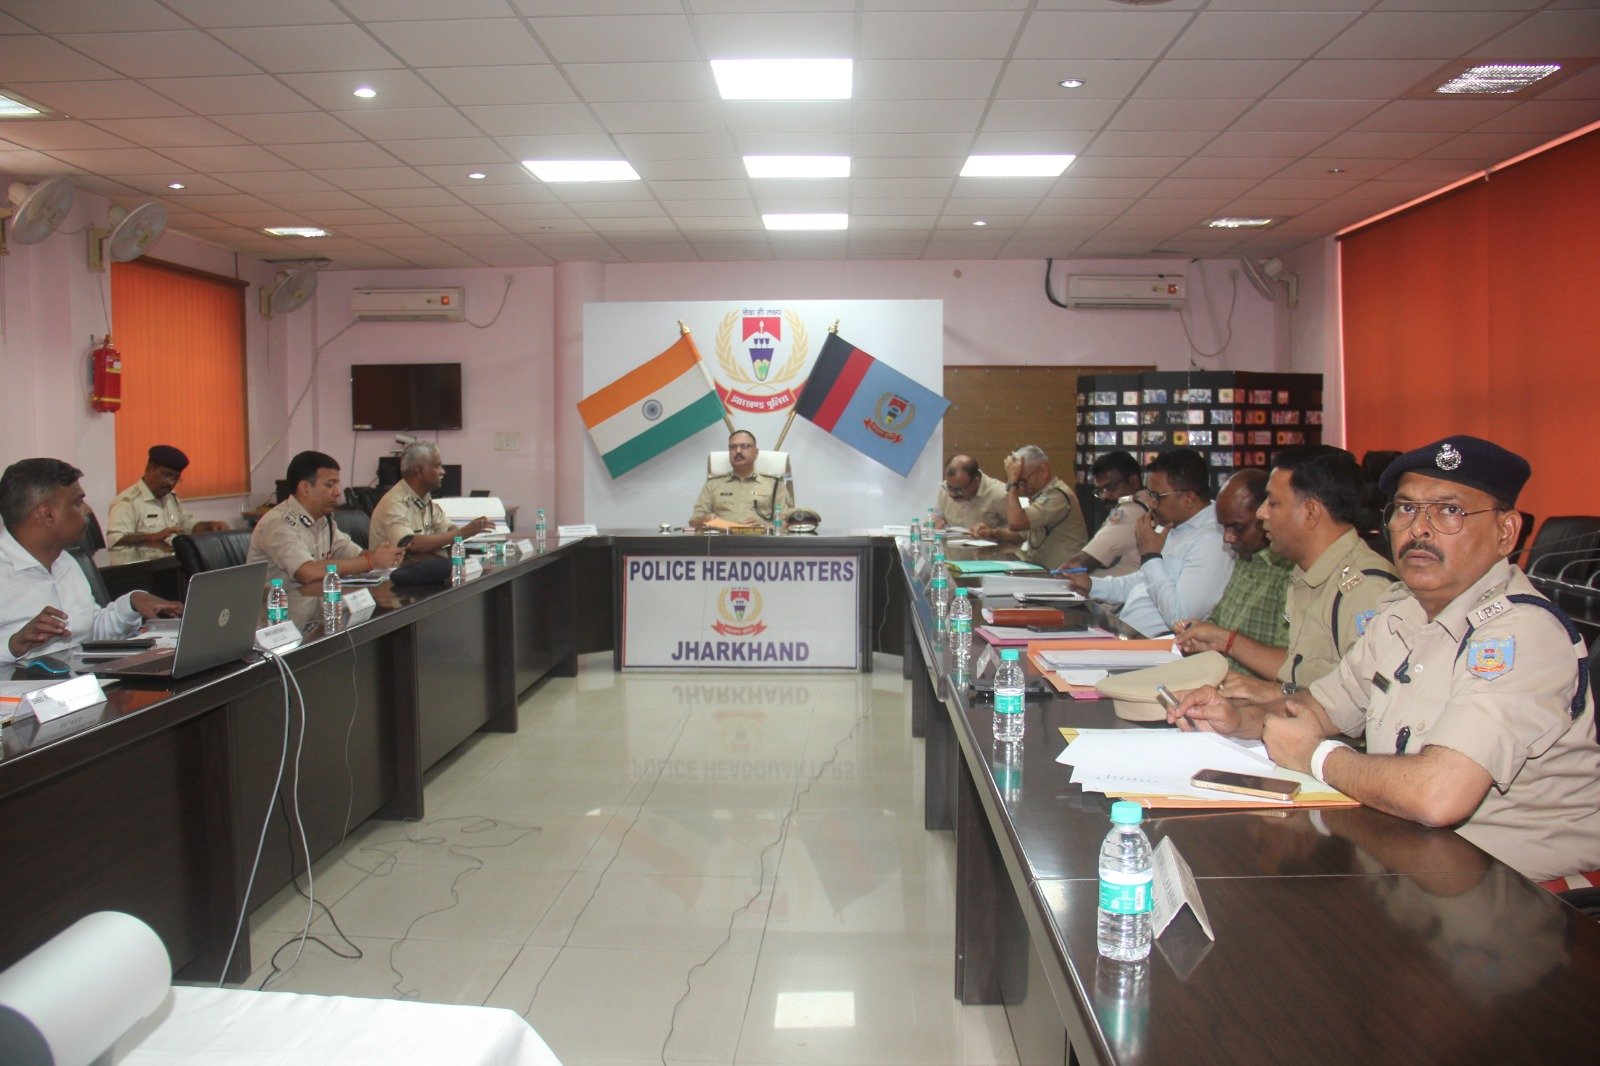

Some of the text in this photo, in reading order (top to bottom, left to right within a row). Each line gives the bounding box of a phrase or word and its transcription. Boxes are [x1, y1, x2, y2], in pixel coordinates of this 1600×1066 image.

[630, 560, 854, 583] POLICE HEADQUARTERS
[671, 641, 810, 661] JHARKHAND
